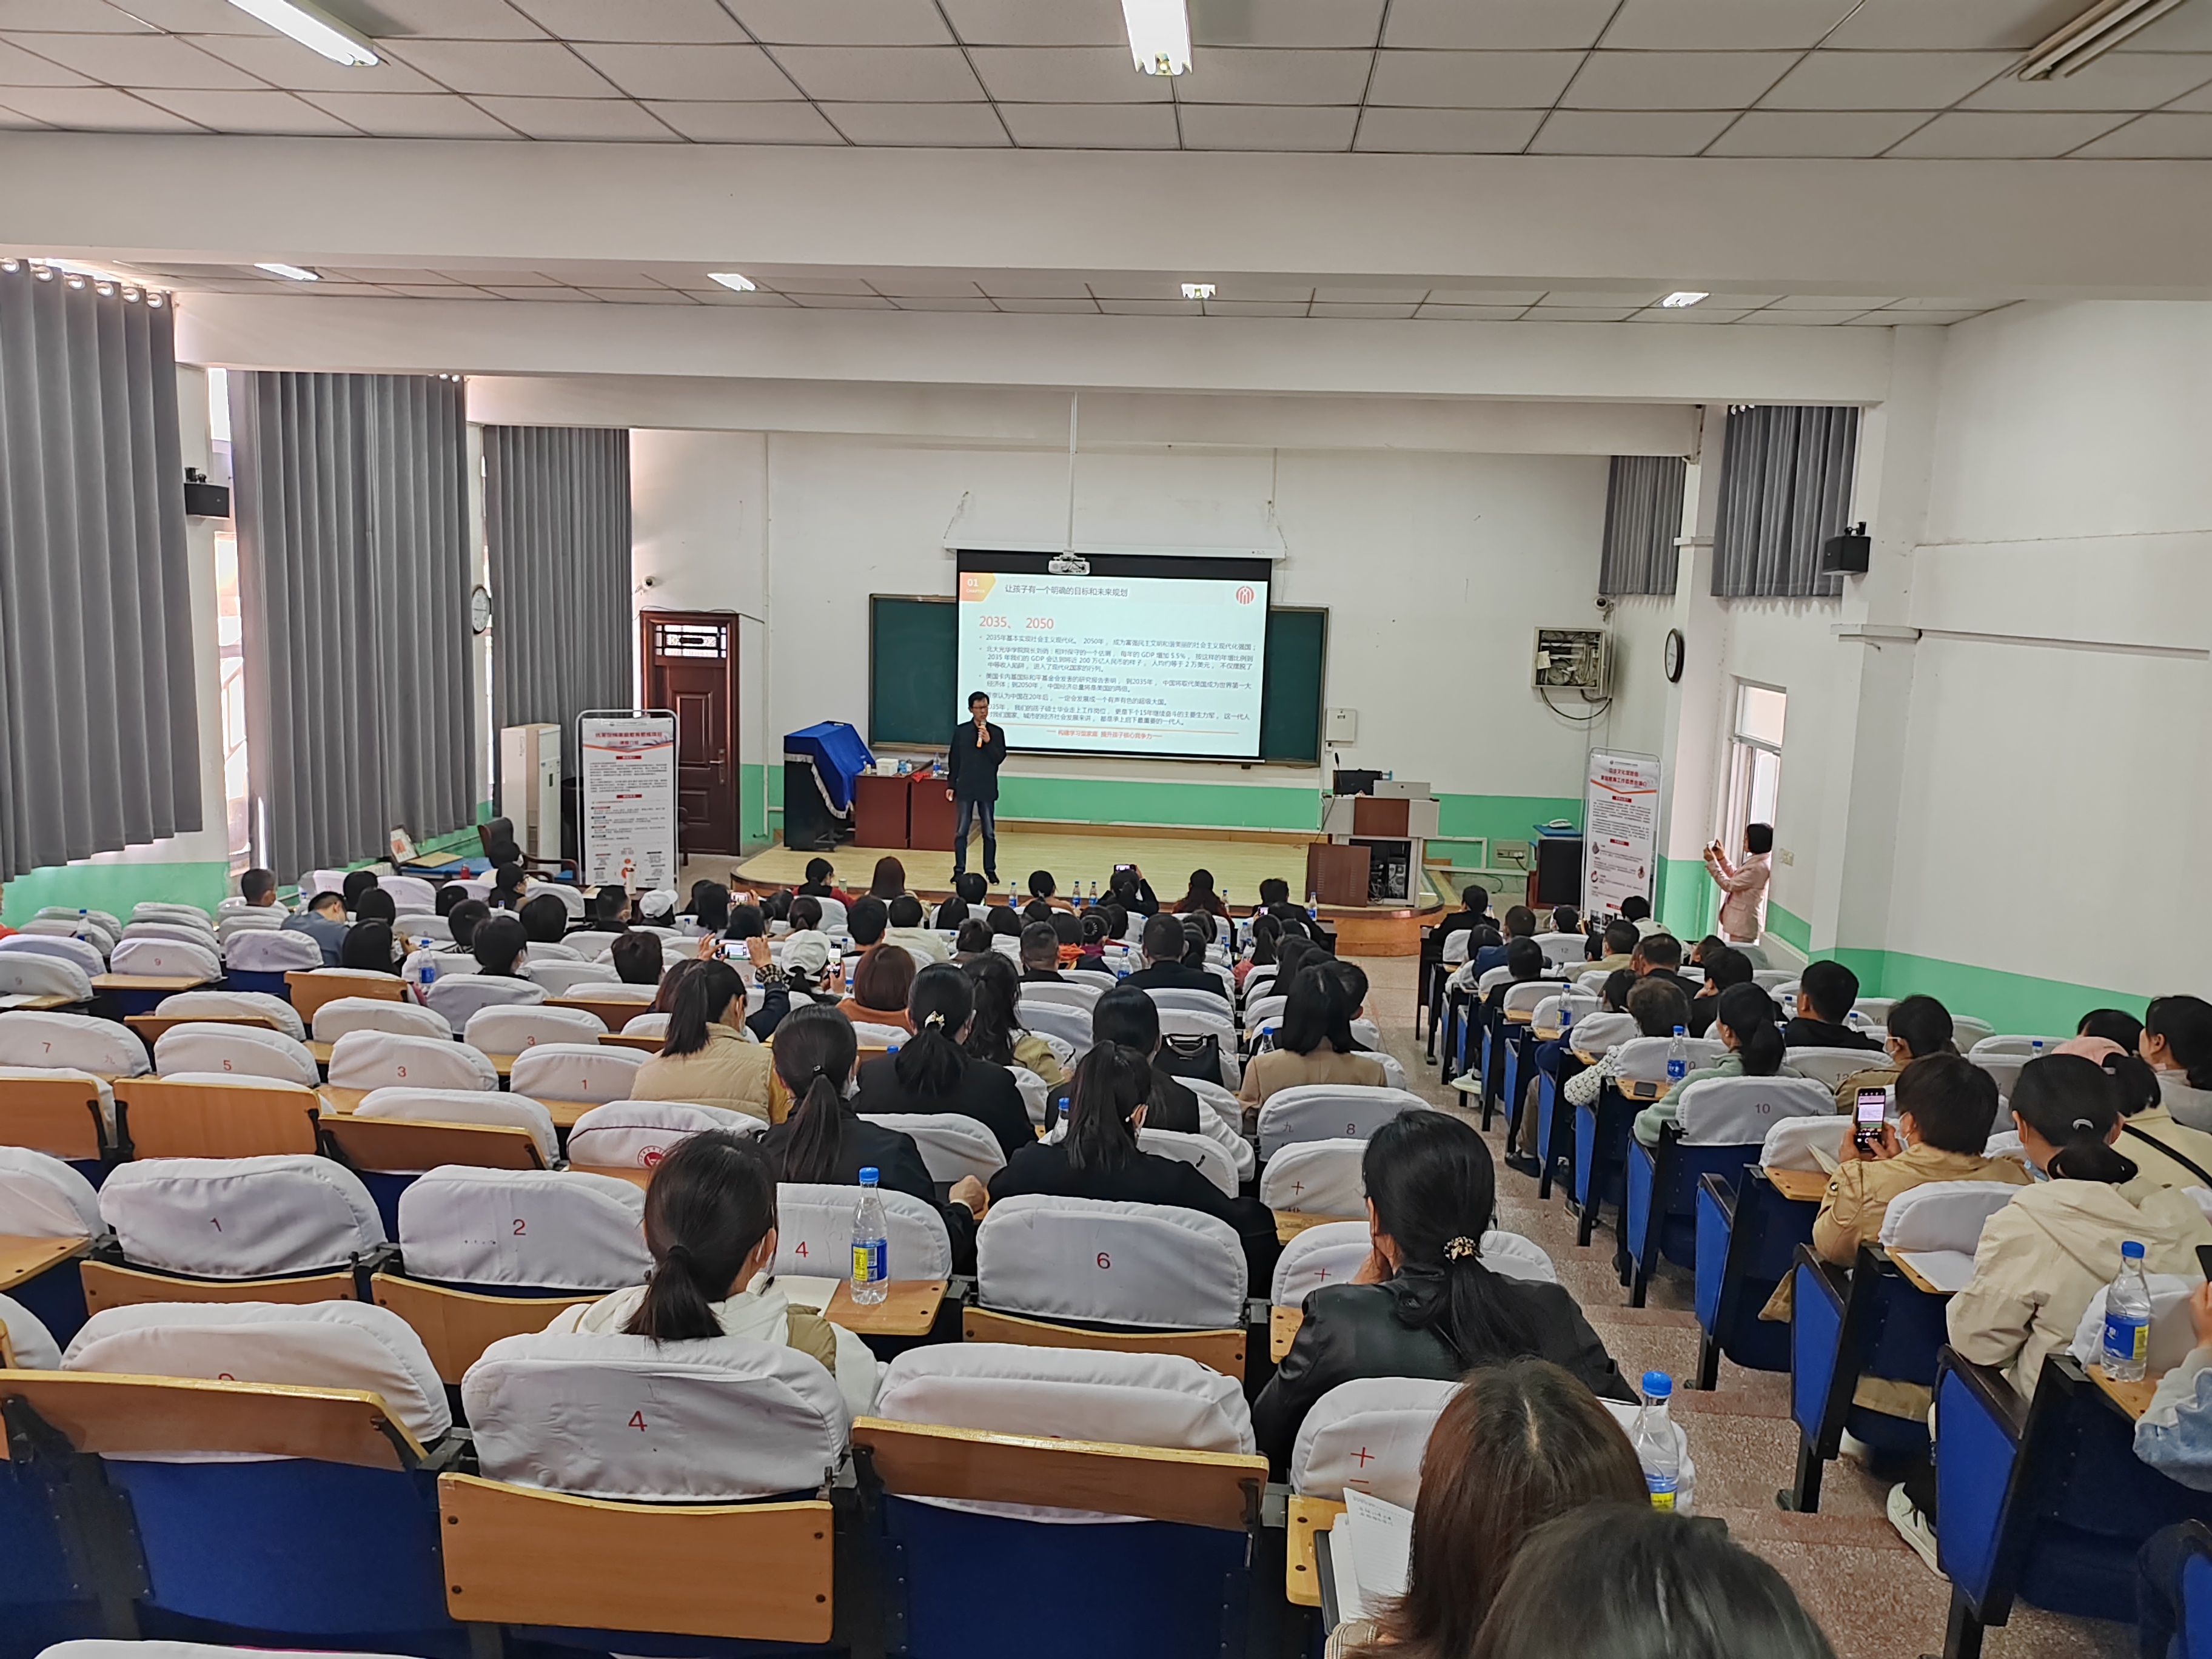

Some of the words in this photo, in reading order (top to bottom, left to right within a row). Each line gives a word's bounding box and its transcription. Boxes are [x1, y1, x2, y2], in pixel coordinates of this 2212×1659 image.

[967, 578, 978, 587] 01
[1005, 585, 1128, 597] 让孩子有一个明确的目标和未来规划
[1026, 618, 1054, 629] 2050
[155, 957, 161, 966] 9
[528, 1036, 535, 1046] 3
[42, 1042, 51, 1053] 7
[223, 1060, 231, 1071] 5
[398, 1066, 406, 1077] 3
[582, 1079, 587, 1090] 1
[1755, 1103, 1770, 1114] 10
[1346, 1124, 1355, 1134] 8
[513, 1219, 526, 1236] 2
[795, 1241, 809, 1258] 4
[1096, 1252, 1111, 1269] 6
[628, 1410, 648, 1432] 4
